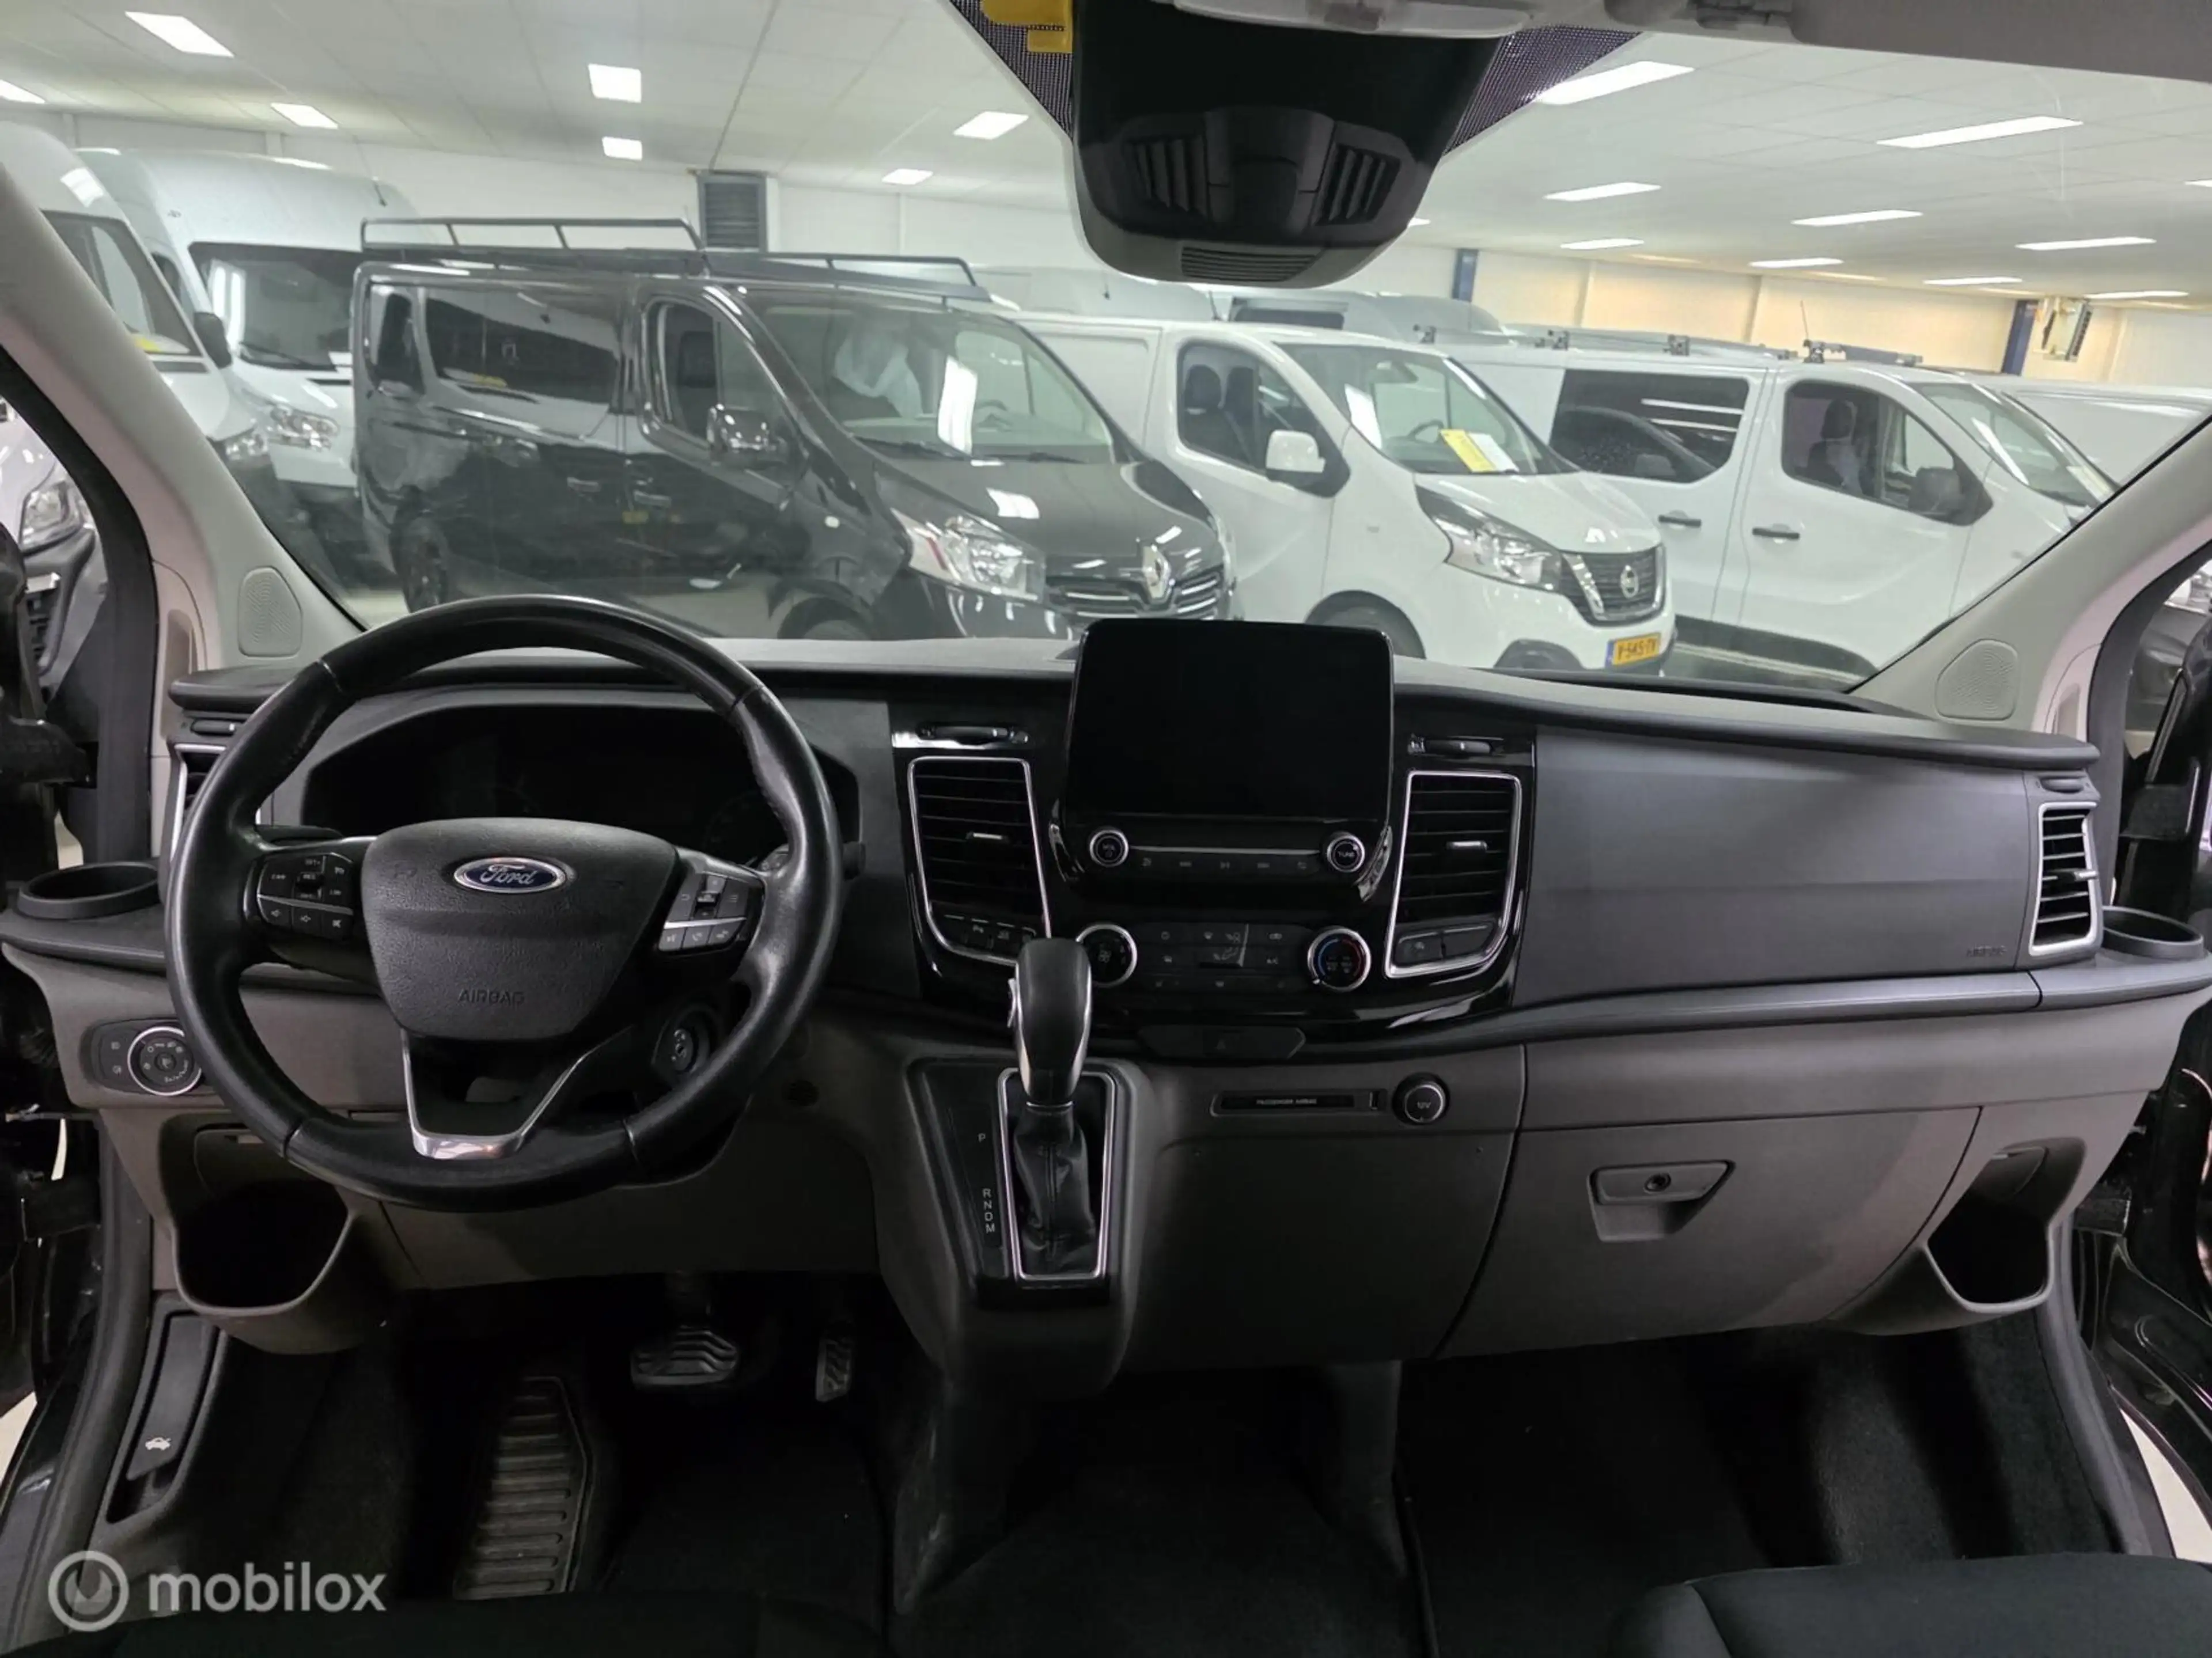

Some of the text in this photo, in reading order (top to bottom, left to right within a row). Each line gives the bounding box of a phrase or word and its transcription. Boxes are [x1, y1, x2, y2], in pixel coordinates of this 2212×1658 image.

[479, 863, 538, 885] Ford
[457, 988, 525, 1004] AIRBAG
[978, 1132, 986, 1143] P
[982, 1187, 991, 1198] R
[983, 1200, 992, 1209] N
[984, 1212, 993, 1221] D
[986, 1223, 995, 1233] M
